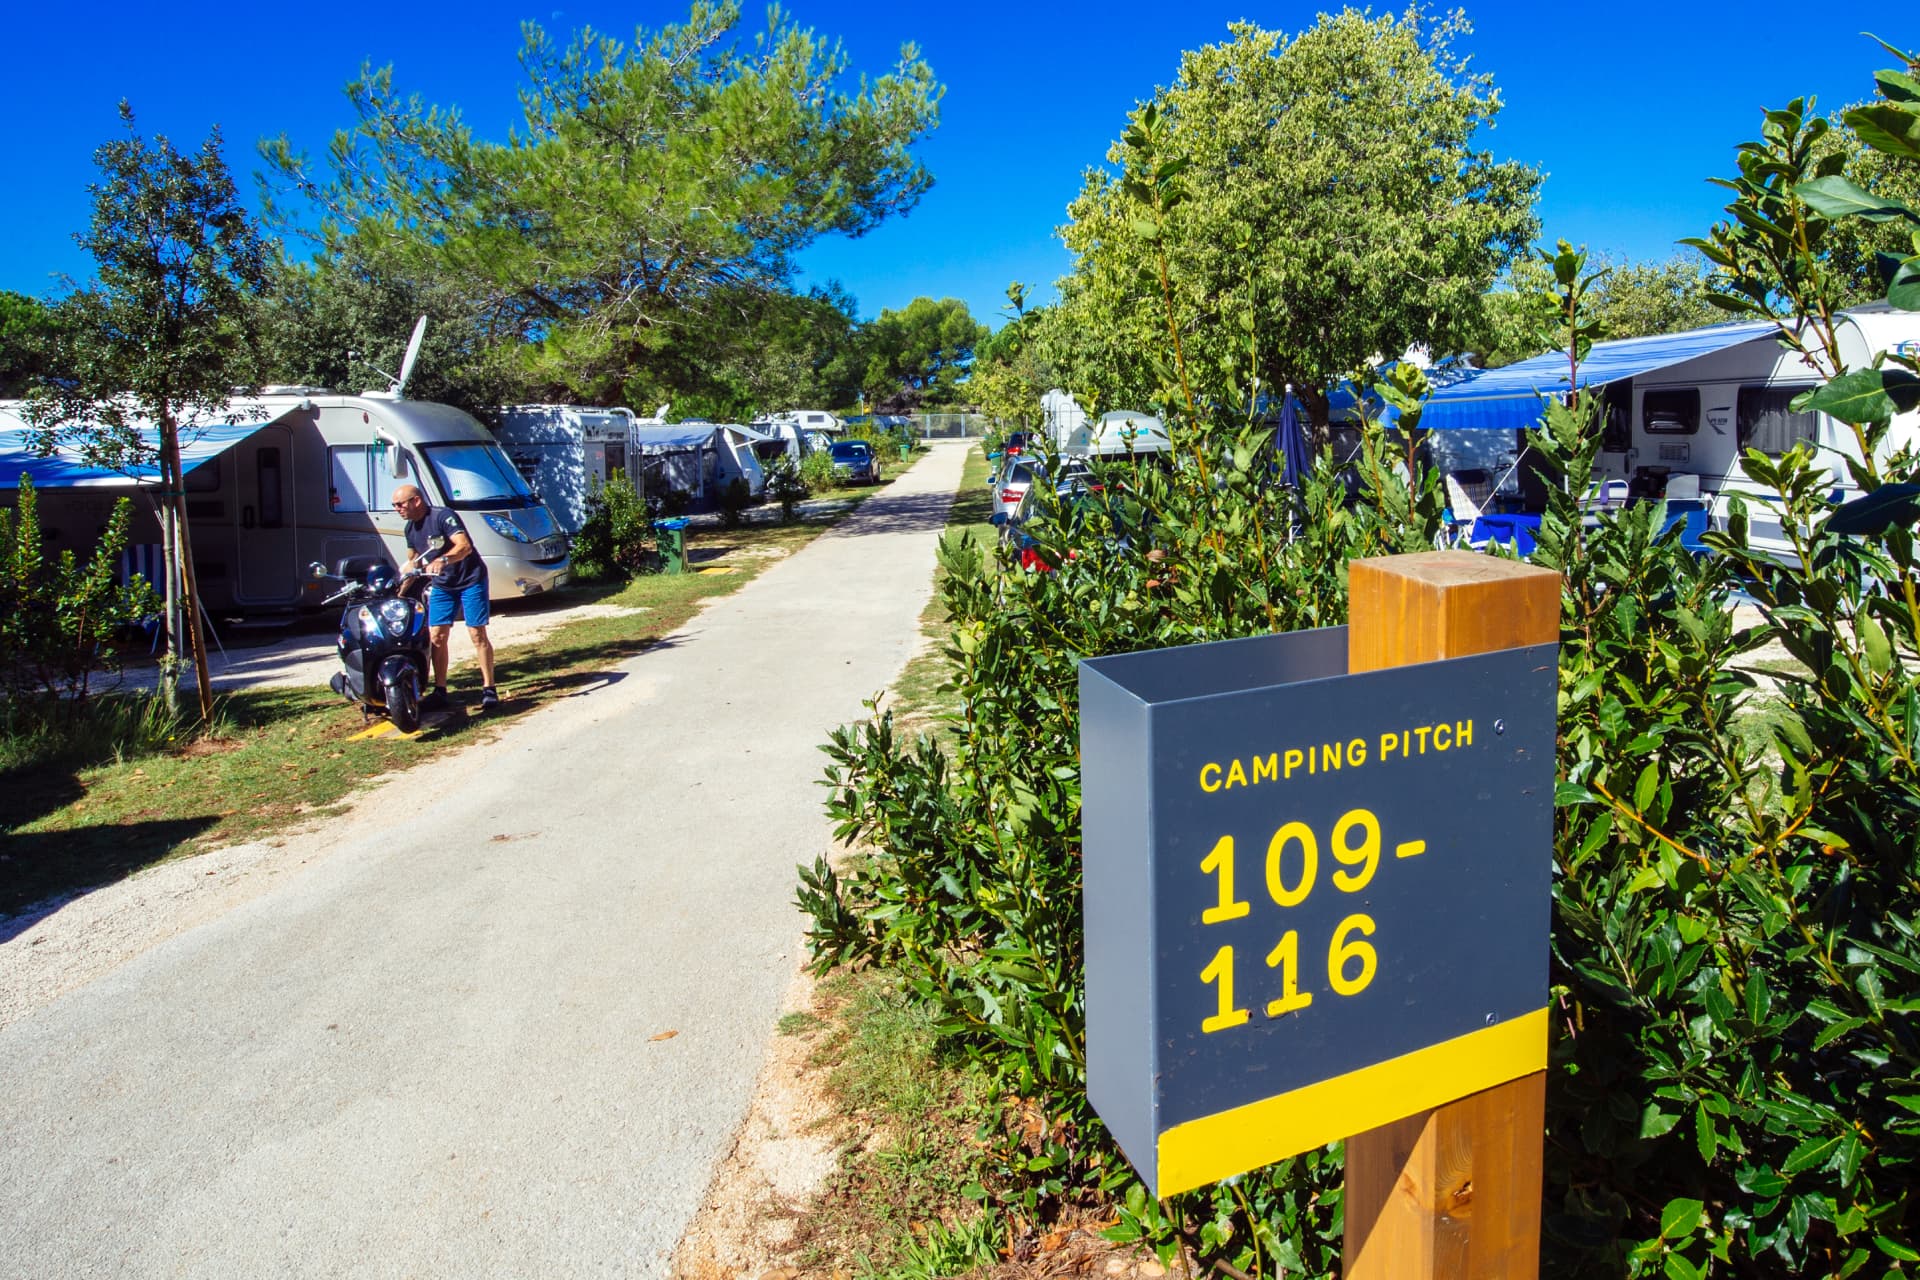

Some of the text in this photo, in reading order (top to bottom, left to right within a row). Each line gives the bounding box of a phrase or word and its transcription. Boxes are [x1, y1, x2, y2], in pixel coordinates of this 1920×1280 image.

[1199, 719, 1473, 793] CAMPING PITCH
[1199, 808, 1426, 925] 109-
[1199, 913, 1378, 1034] 116
